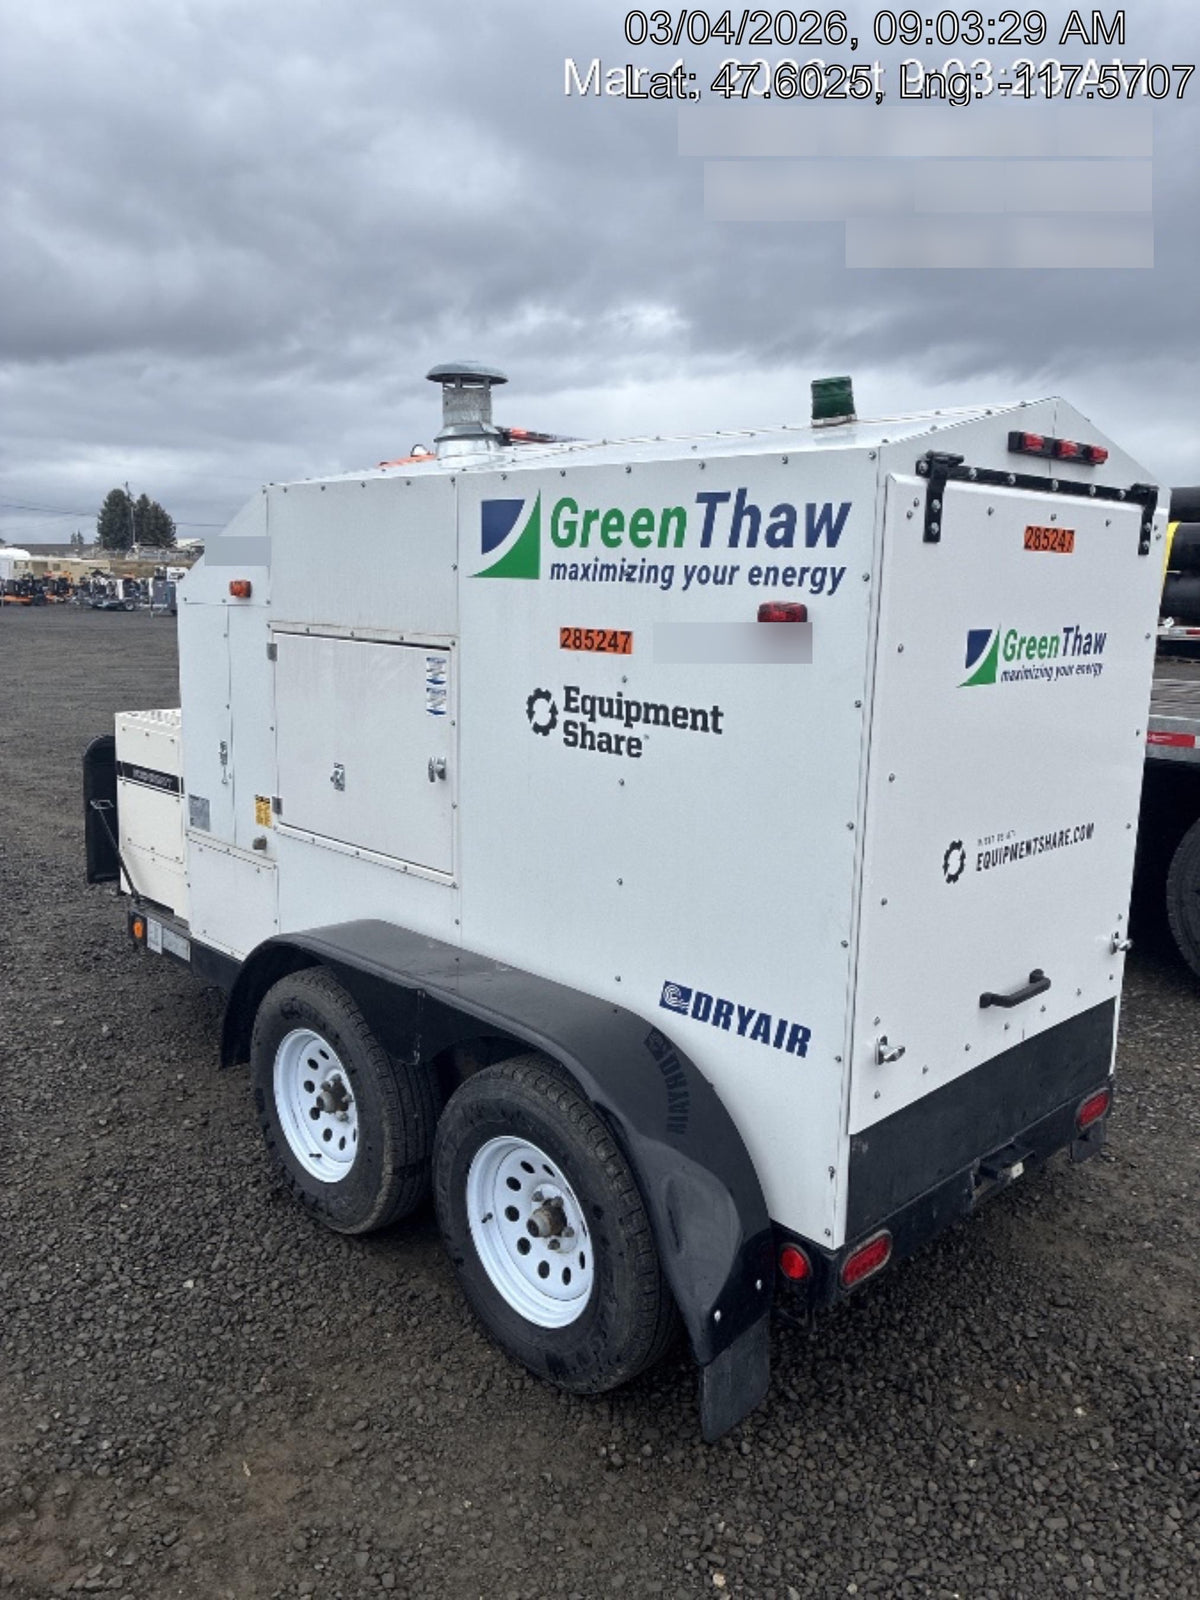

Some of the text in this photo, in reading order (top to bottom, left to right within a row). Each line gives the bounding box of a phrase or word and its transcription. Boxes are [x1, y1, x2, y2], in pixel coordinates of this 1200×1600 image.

[1024, 526, 1075, 553] 285247
[550, 555, 847, 596] maximizing your energy
[560, 627, 633, 654] 285247
[563, 685, 725, 735] Equipment
[562, 719, 643, 758] Share
[975, 822, 1095, 872] EQUIPMENTSHARE.COM
[690, 989, 812, 1058] DRYAIR
